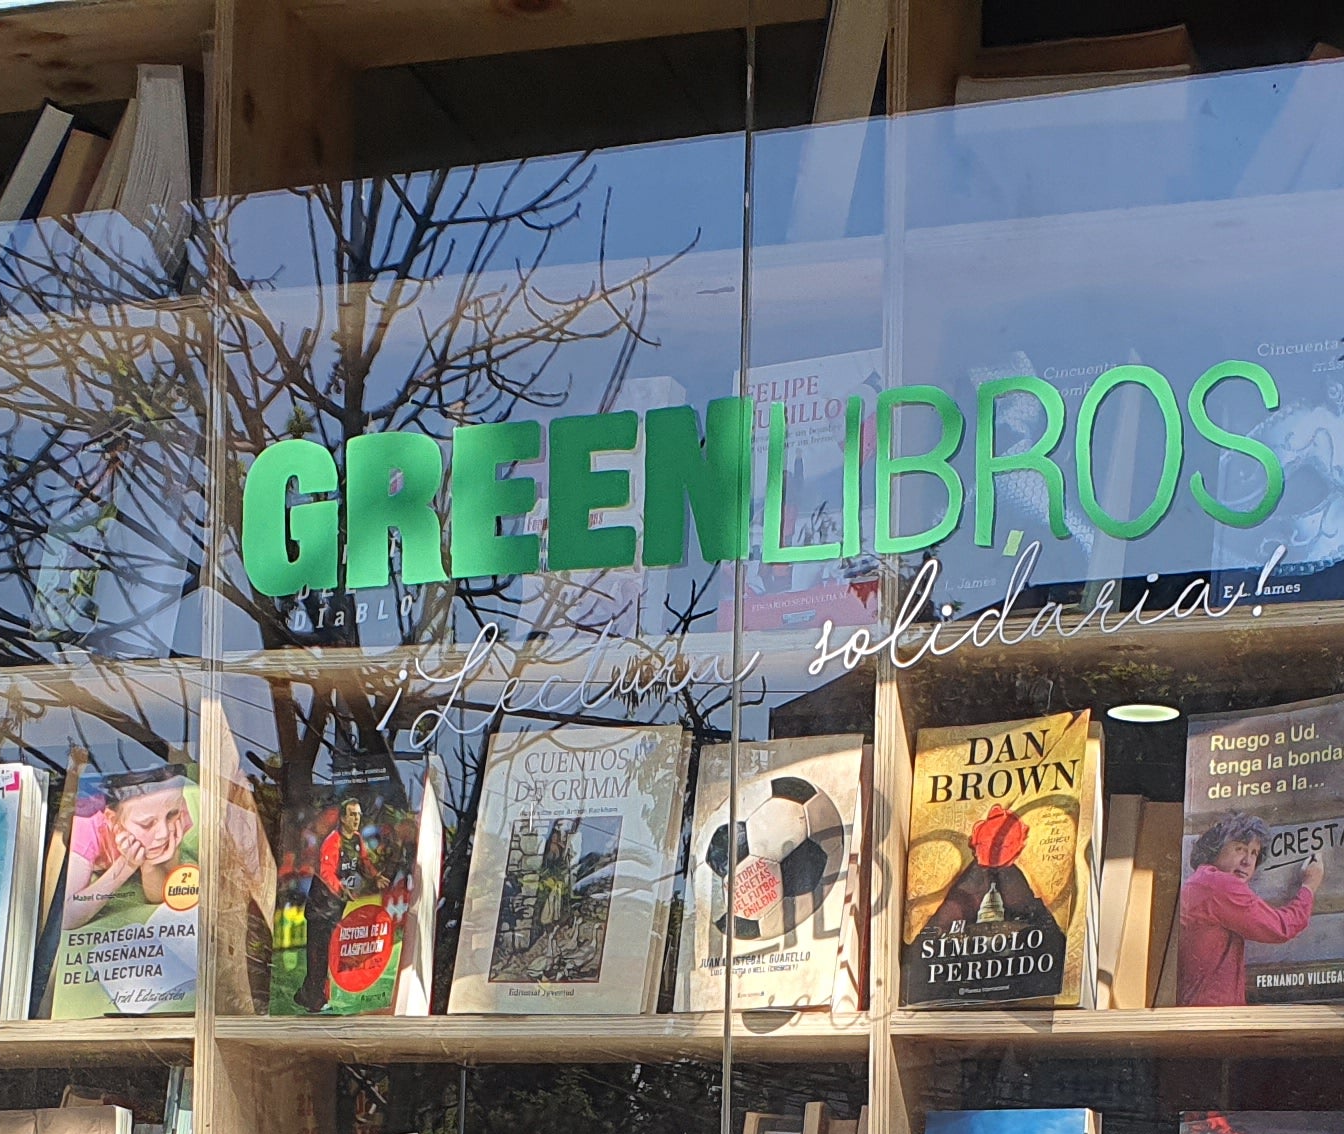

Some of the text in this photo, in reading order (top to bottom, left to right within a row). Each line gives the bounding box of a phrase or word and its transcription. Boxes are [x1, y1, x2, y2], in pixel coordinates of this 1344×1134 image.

[808, 540, 1287, 676] solidaria!
[965, 729, 1050, 767] DAN
[1210, 723, 1320, 753] Ruego a Ud.
[524, 747, 630, 774] CUENTOS
[1208, 756, 1262, 777] tenga
[1267, 754, 1283, 769] la
[927, 758, 1081, 804] BROWN
[1208, 773, 1325, 800] de irse a la...
[68, 924, 196, 947] ESTRATEGIAS PARA
[921, 928, 1044, 960] SÍMBOLO
[65, 944, 165, 966] LA ENSEÑANZA
[927, 952, 1055, 985] PERDIDO
[63, 964, 163, 985] DE LA LECTURA
[1256, 972, 1305, 989] FERNANDO
